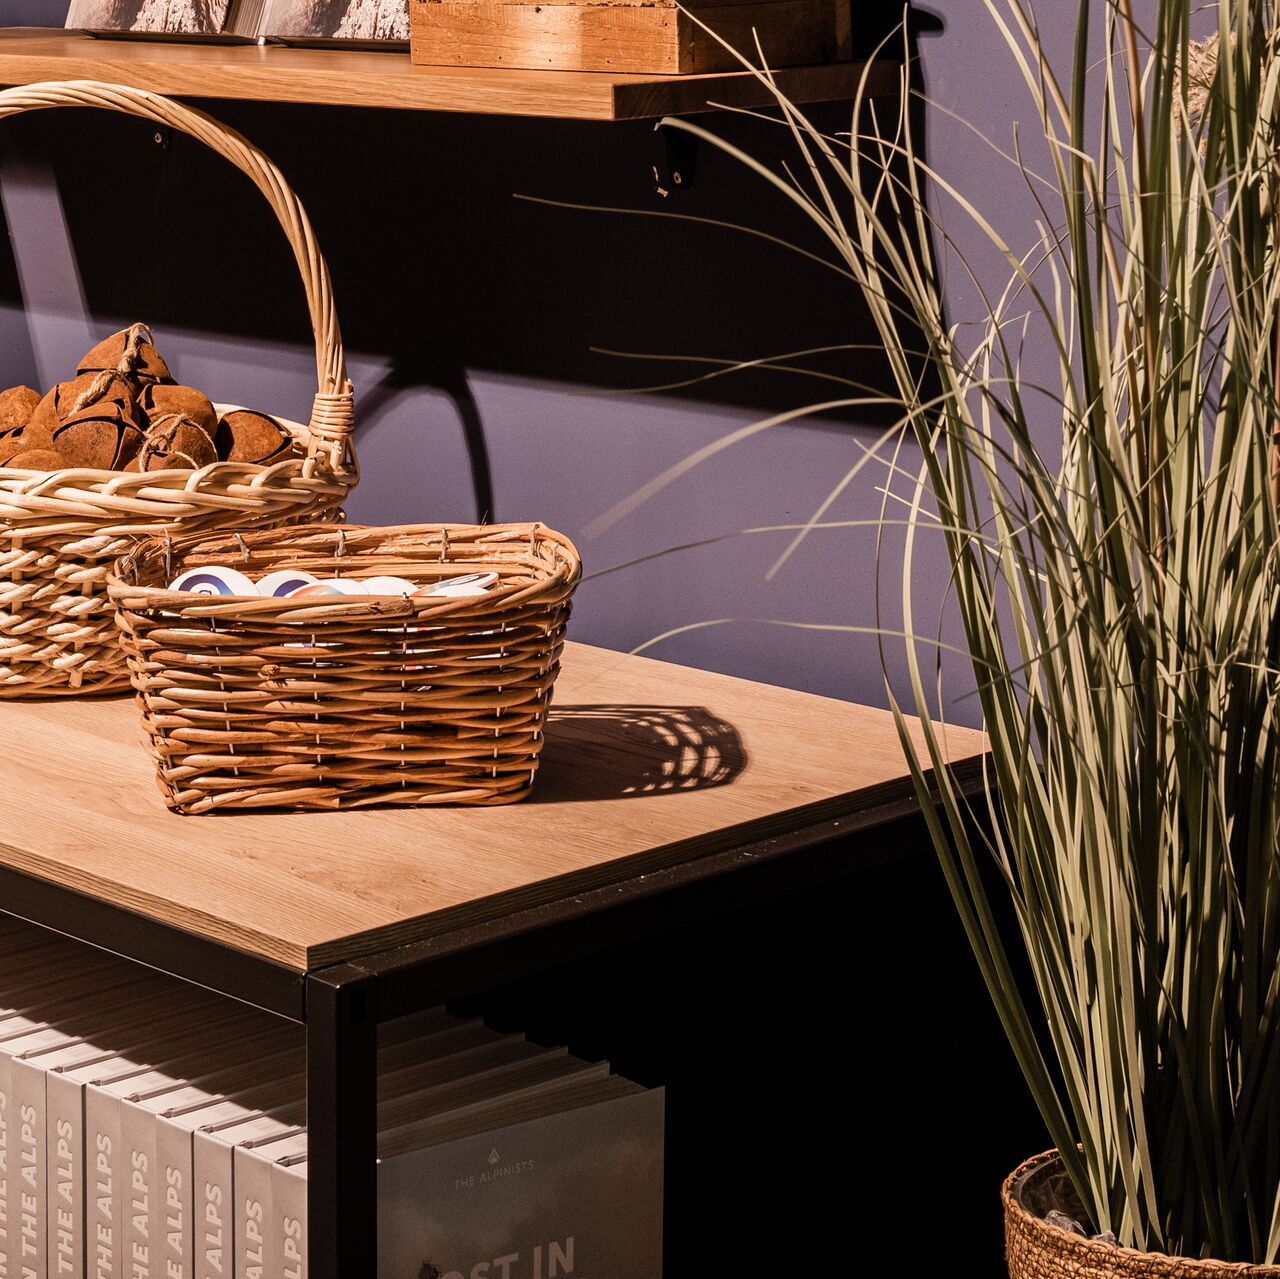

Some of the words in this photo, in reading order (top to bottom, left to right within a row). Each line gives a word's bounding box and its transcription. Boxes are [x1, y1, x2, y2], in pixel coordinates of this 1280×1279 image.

[20, 1105, 37, 1189] ALPS
[56, 1119, 74, 1205] ALPS
[96, 1134, 113, 1220] ALPS
[454, 1175, 475, 1190] THE
[479, 1159, 534, 1184] ALPINISTS
[21, 1192, 38, 1257] THE
[131, 1151, 149, 1239] ALPS
[166, 1167, 183, 1256] ALPS
[205, 1183, 223, 1273] ALPS
[57, 1208, 74, 1274] THE
[283, 1217, 302, 1279] LPS
[533, 1237, 575, 1279] IN
